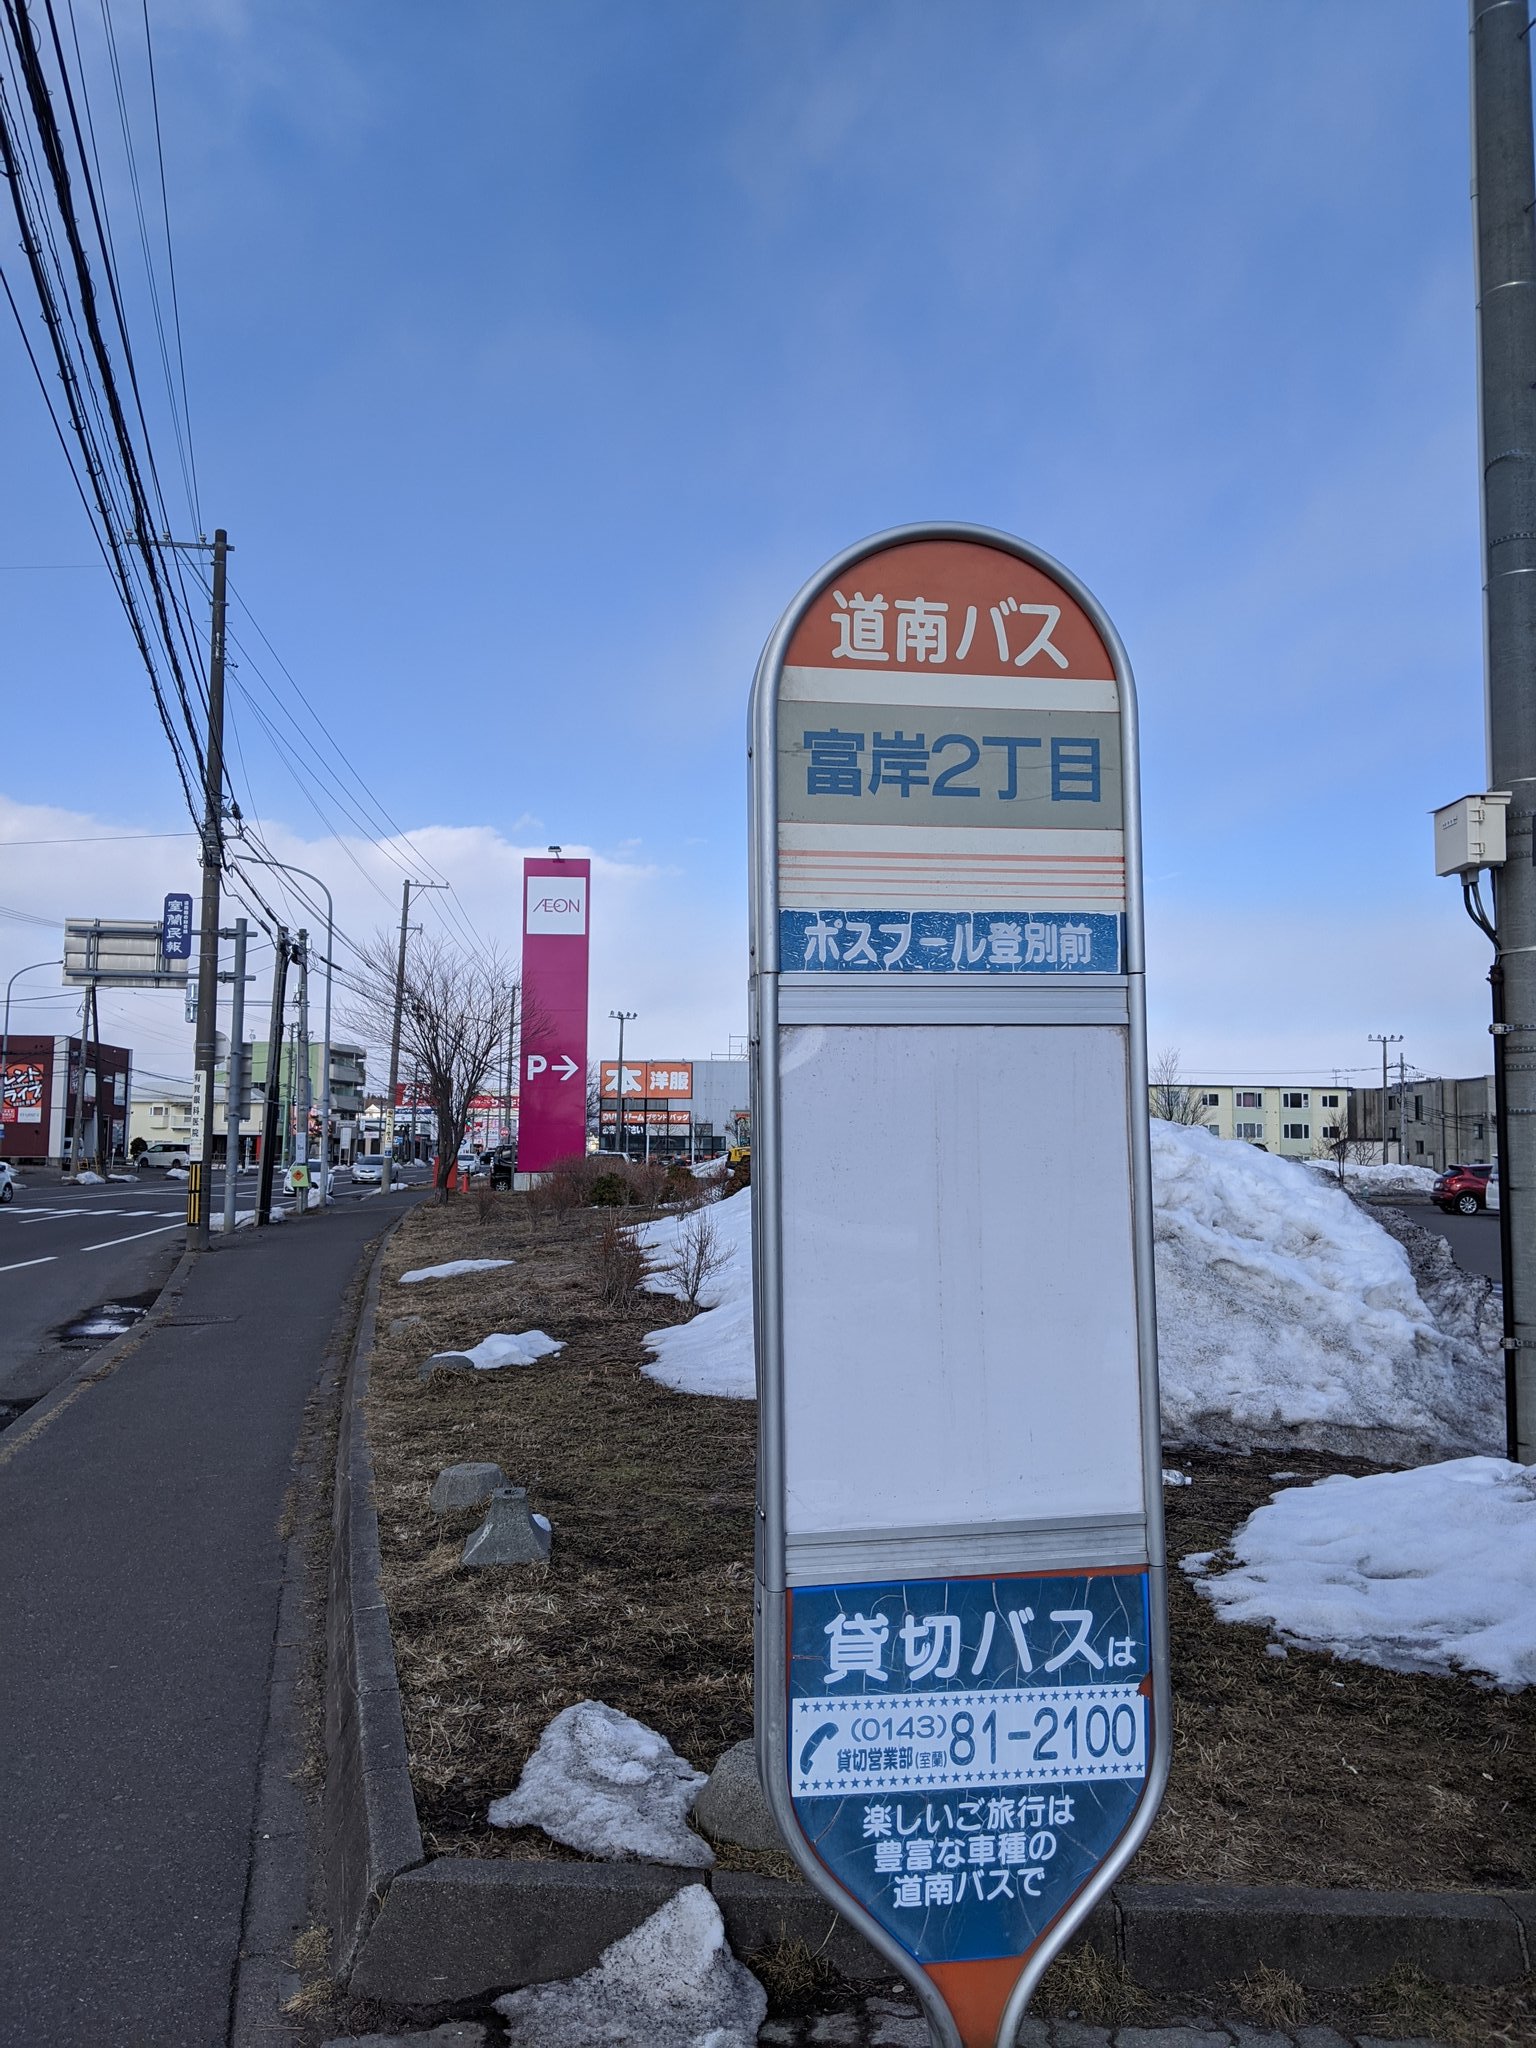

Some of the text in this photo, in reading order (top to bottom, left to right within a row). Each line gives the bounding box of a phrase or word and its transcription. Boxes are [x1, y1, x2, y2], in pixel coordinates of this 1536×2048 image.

[830, 589, 1069, 669] 道南バス
[803, 728, 1101, 802] 富岸2丁目
[166, 899, 183, 953] 室蘭民報
[804, 919, 1092, 964] ポスフール登別前
[527, 1055, 547, 1081] P
[605, 1065, 689, 1094] 本 洋服
[823, 1607, 1136, 1684] 貸切バスは
[862, 1795, 1075, 1838] 楽しいご旅行は
[874, 1830, 1057, 1873] 豊富な車種の
[893, 1867, 1046, 1909] 道南バスで
